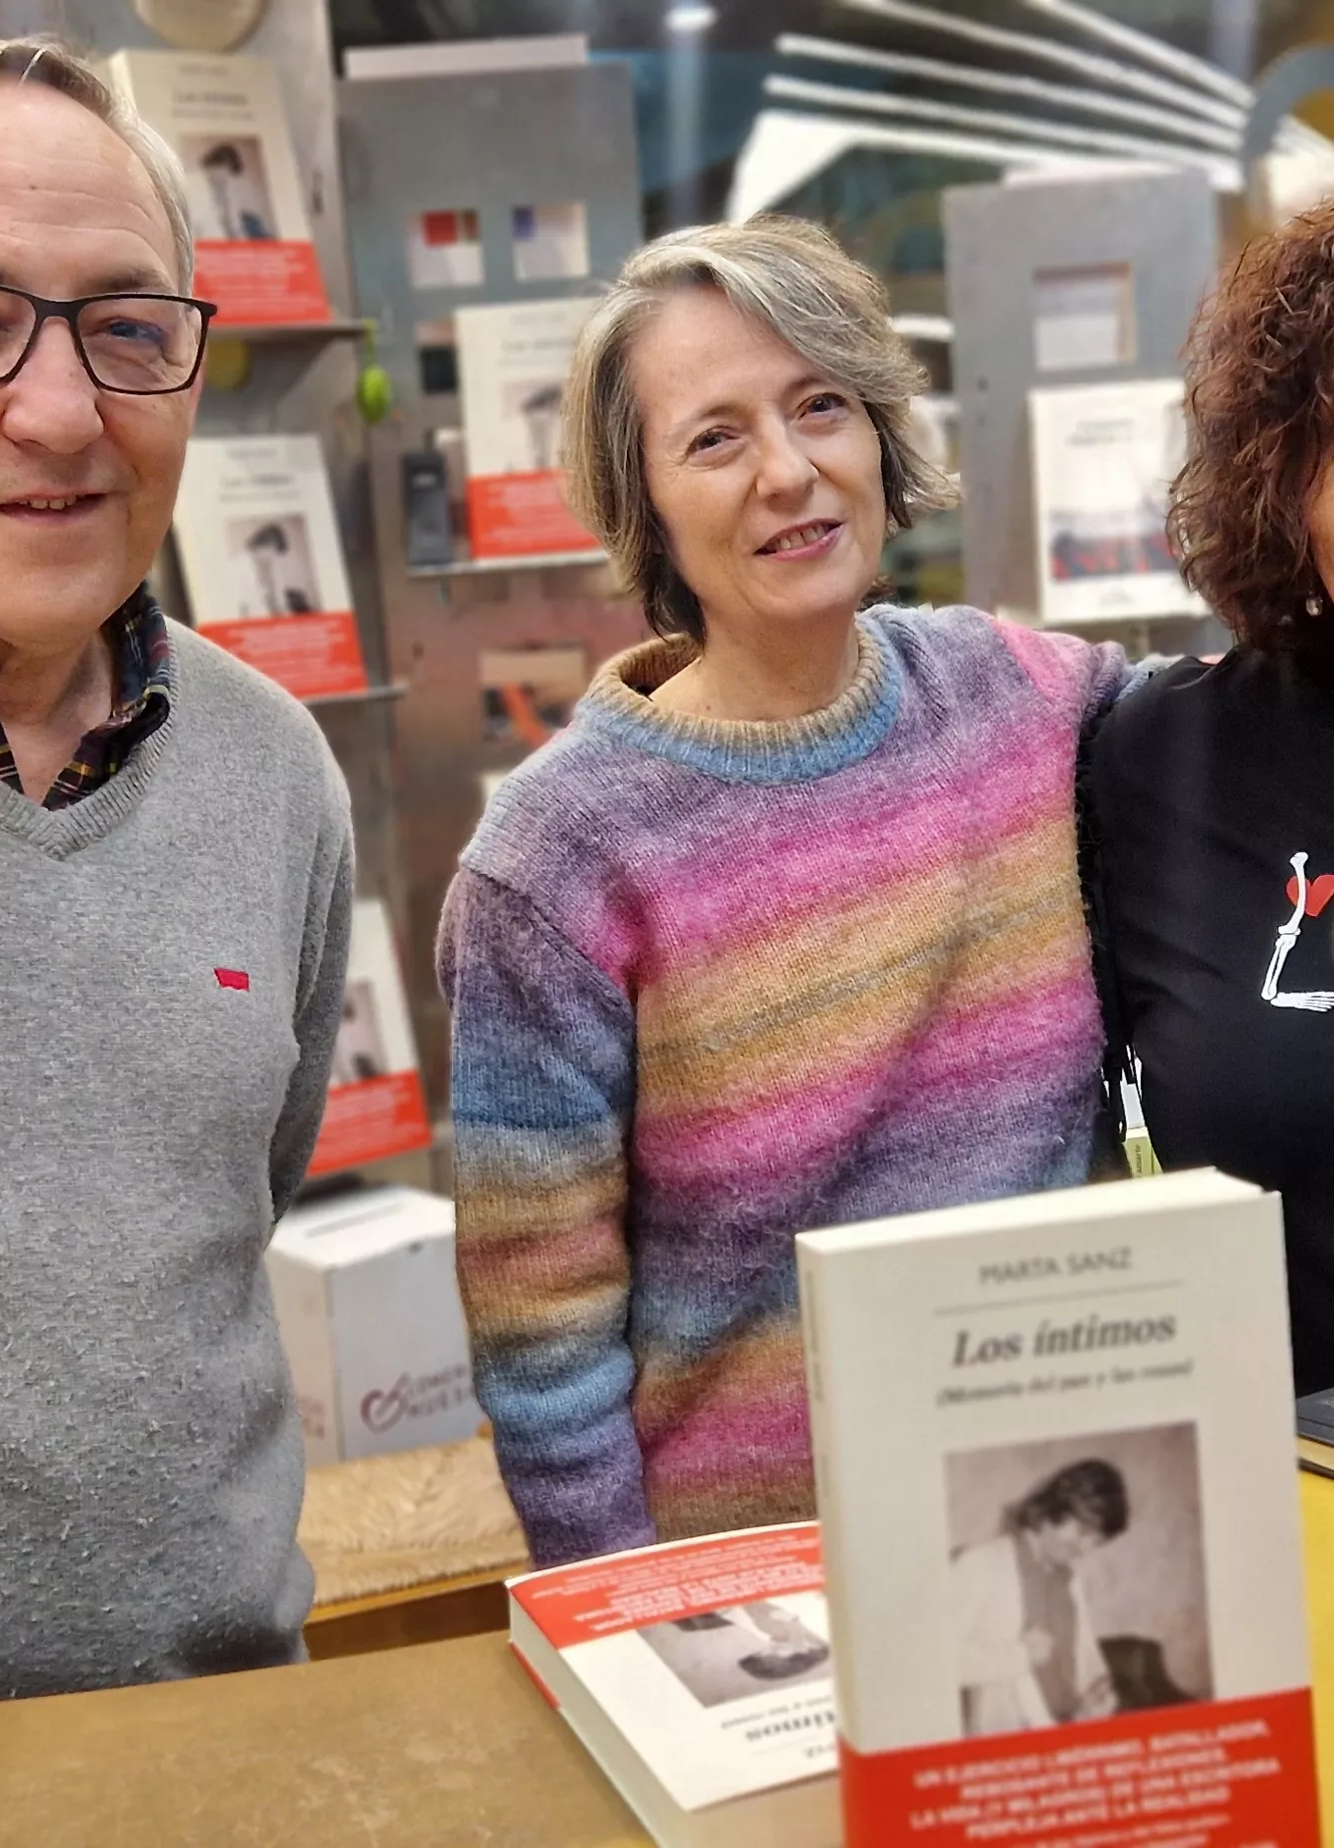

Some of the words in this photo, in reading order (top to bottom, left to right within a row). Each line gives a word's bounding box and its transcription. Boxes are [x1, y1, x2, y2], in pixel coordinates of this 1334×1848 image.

[978, 1256, 1062, 1285] MARTA
[1067, 1246, 1133, 1276] SANZ
[952, 1329, 1023, 1368] Los
[1032, 1312, 1178, 1358] íntimos
